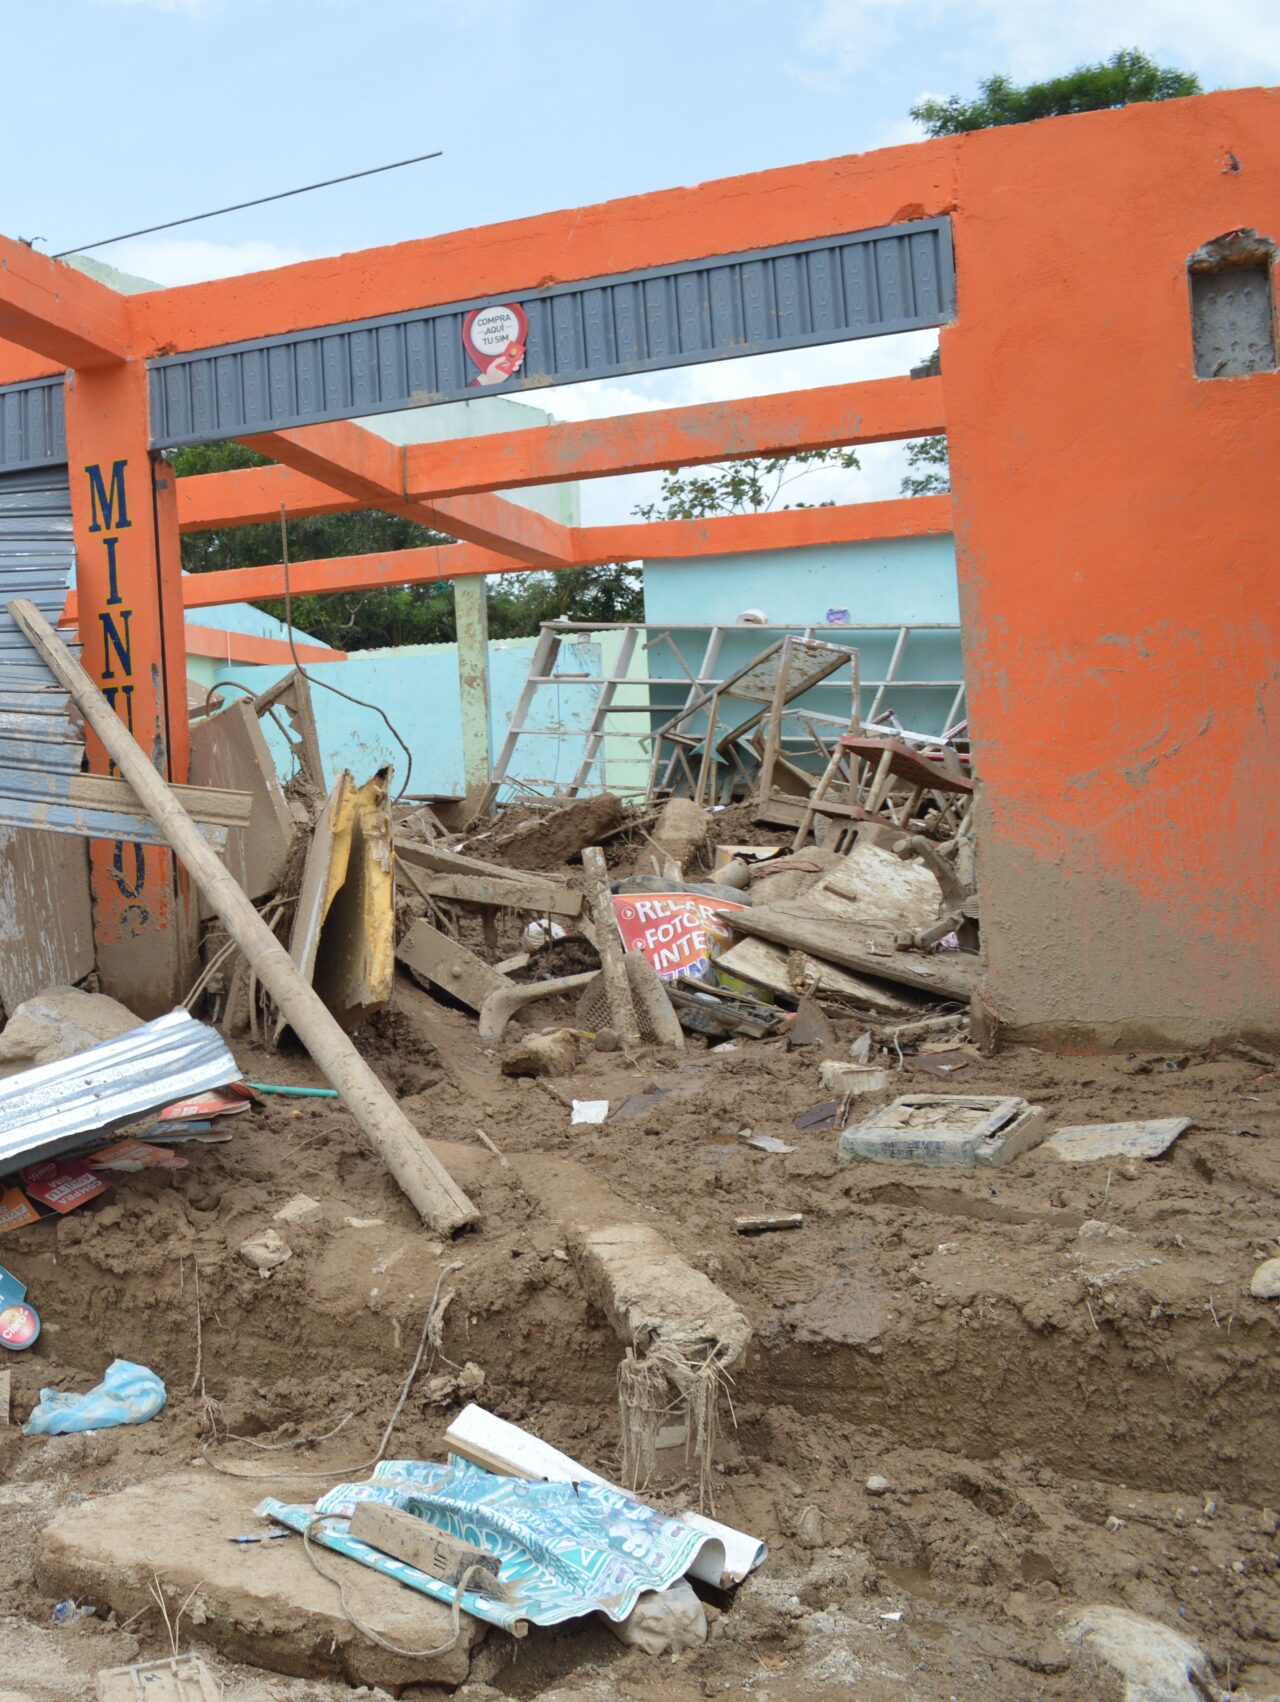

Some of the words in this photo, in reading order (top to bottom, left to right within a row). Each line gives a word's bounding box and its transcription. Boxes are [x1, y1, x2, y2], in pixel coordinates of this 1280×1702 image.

[477, 313, 511, 327] COMPRA
[483, 337, 493, 345] TU
[495, 334, 509, 344] SIM
[58, 1180, 103, 1204] COMPRA
[2, 1312, 27, 1339] Claro
